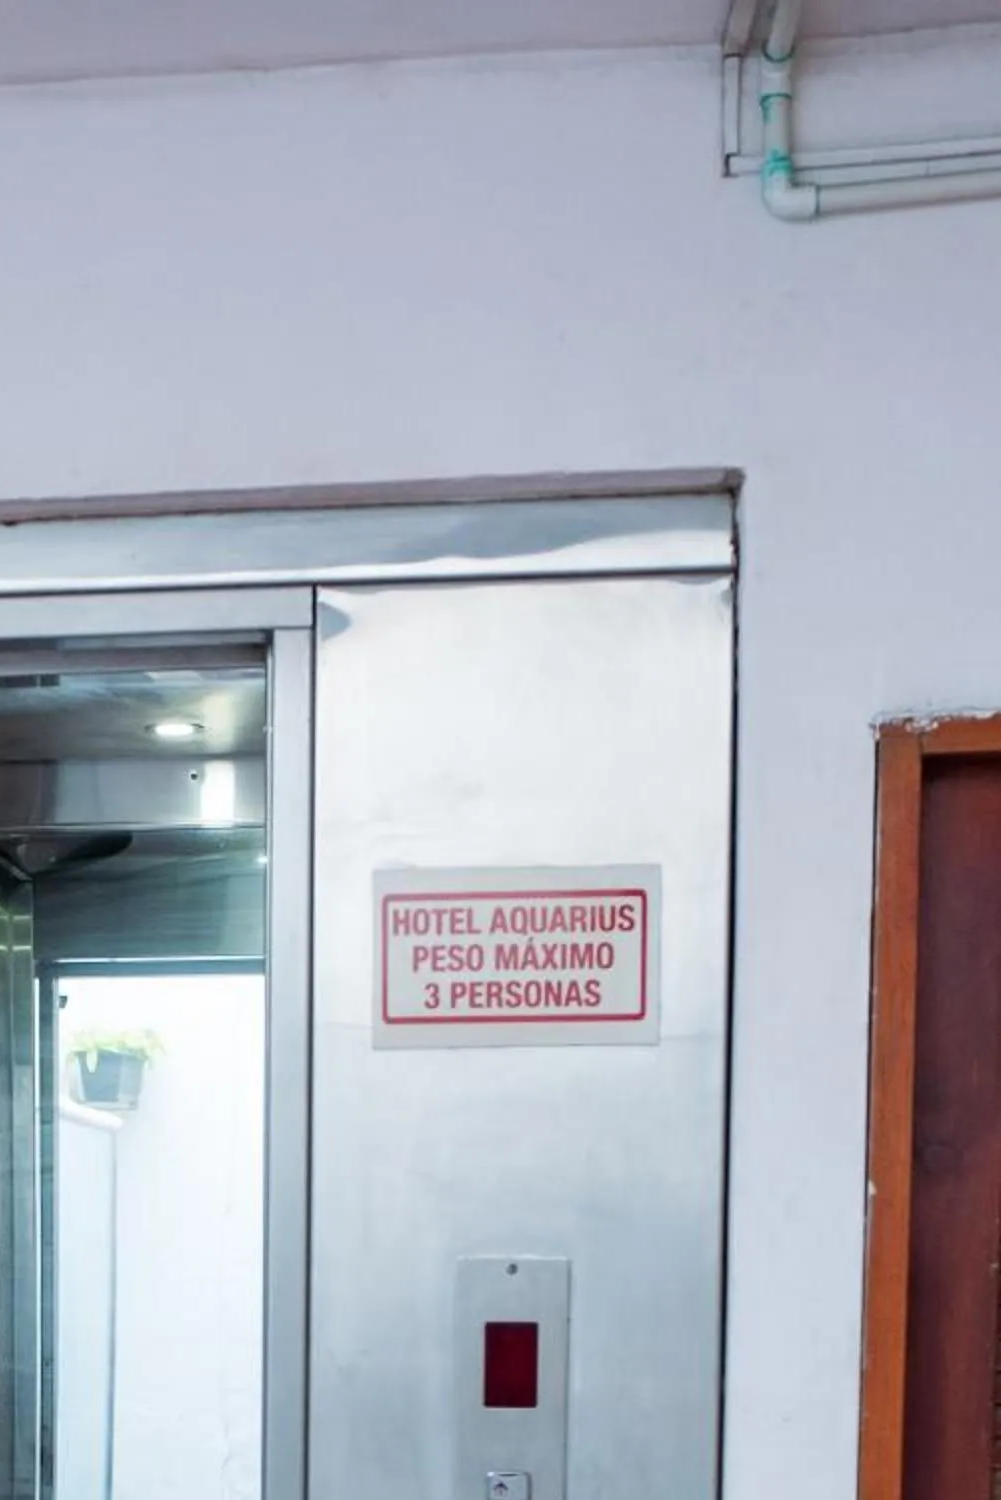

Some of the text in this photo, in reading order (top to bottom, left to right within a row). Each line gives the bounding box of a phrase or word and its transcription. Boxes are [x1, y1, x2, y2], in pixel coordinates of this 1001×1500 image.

[392, 904, 635, 936] HOTEL AQUARIUS
[412, 937, 614, 972] PESO MÁXIMO
[424, 979, 602, 1009] 3 PERSONAS
